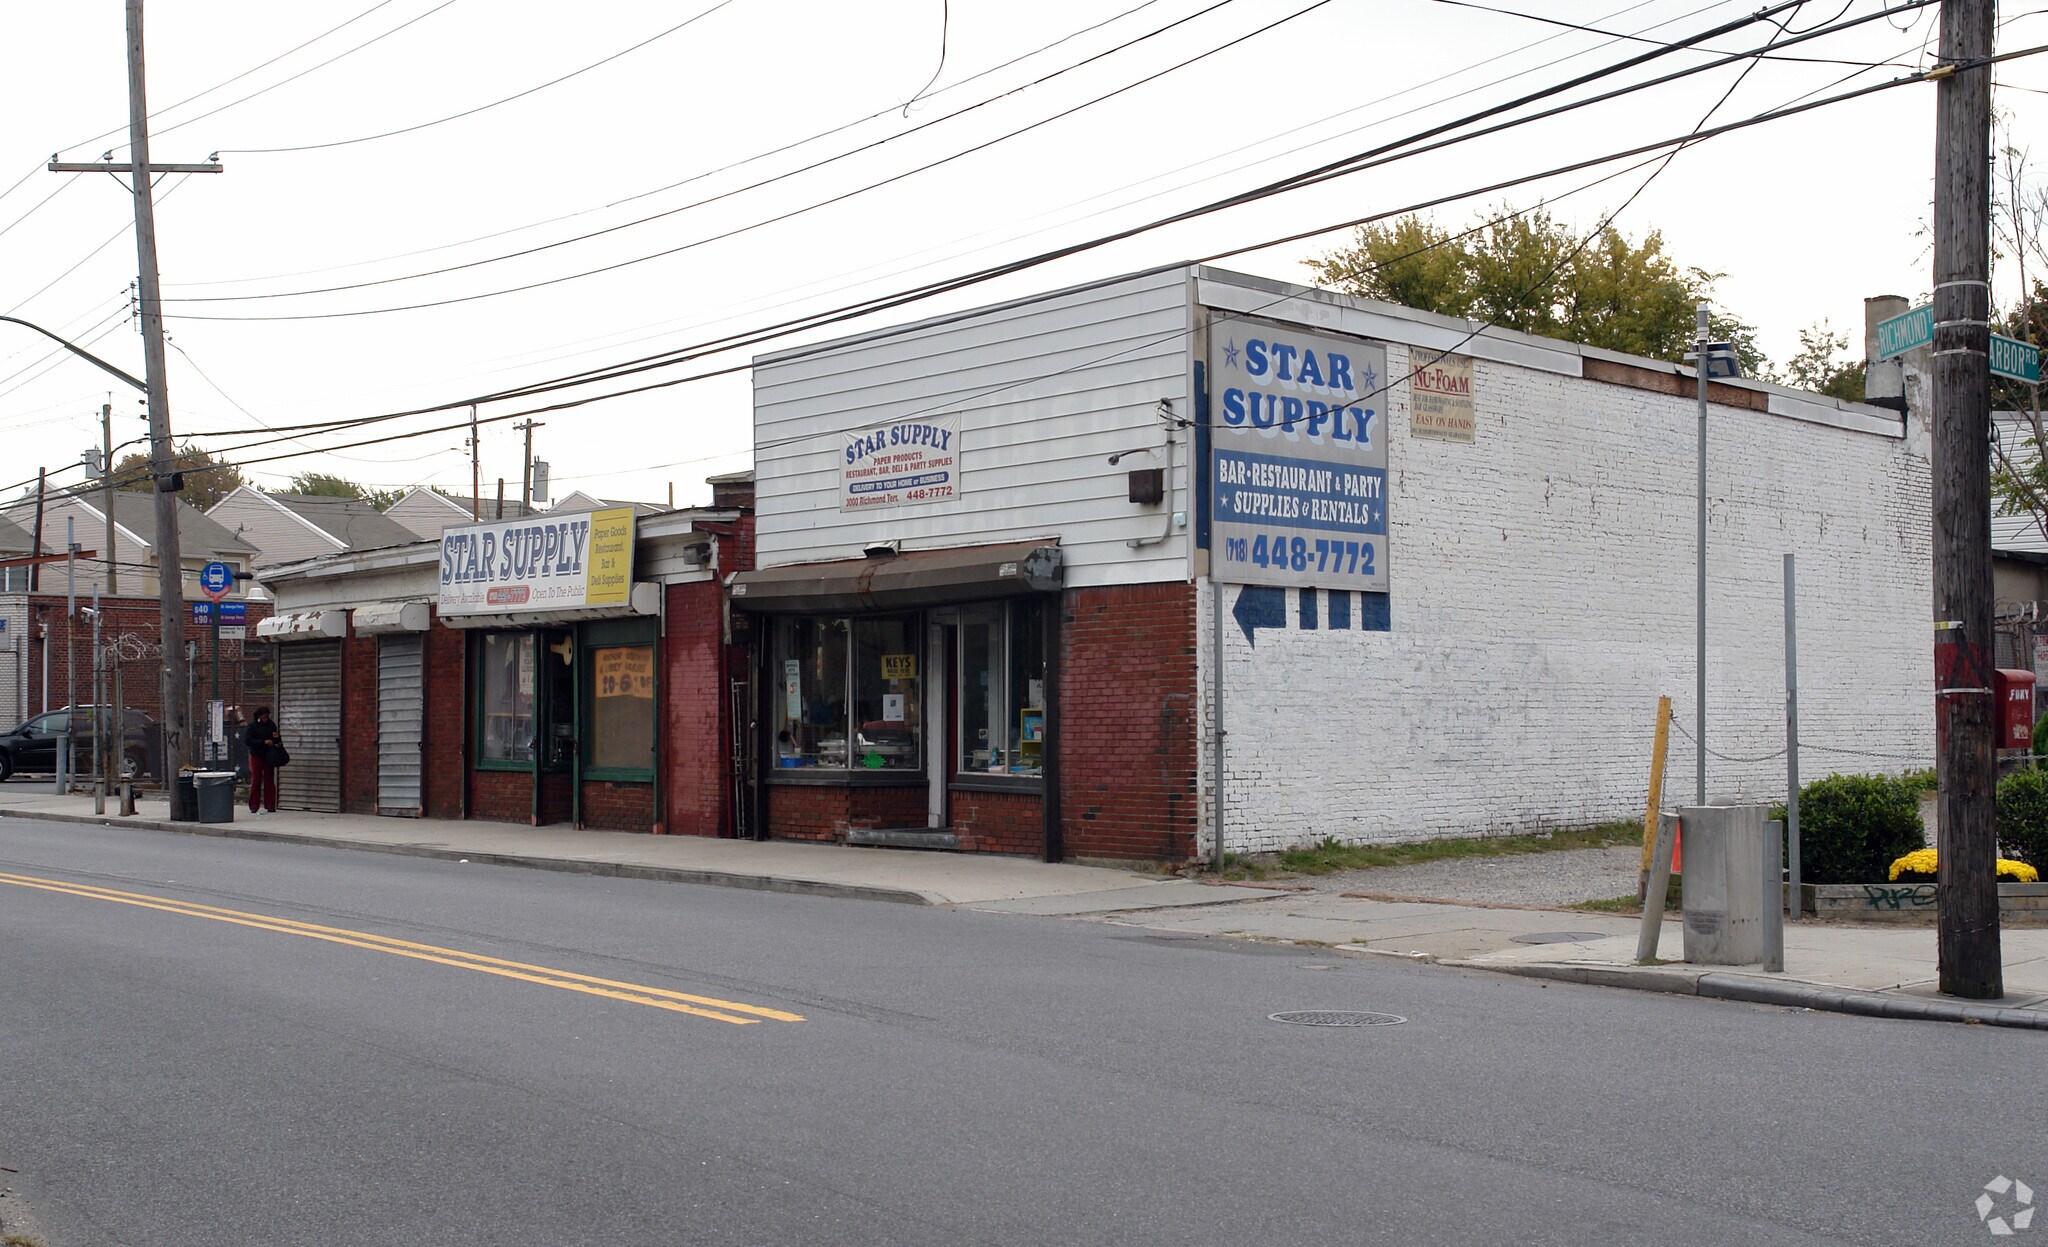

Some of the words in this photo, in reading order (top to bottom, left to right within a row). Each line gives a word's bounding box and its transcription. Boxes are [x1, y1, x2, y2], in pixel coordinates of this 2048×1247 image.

[1879, 313, 1928, 355] RICHMOND
[1245, 338, 1356, 395] STAR
[2025, 350, 2037, 366] RD
[1222, 386, 1376, 448] SUPPLY
[1416, 414, 1434, 425] EASY
[1436, 416, 1445, 428] ON
[1448, 417, 1472, 430] HANDS
[846, 429, 887, 465] STAR
[890, 424, 953, 452] SUPPLY
[873, 455, 892, 466] PAPER
[893, 451, 923, 463] PRODUCTS
[892, 465, 903, 474] DELI
[904, 463, 909, 471] &
[910, 461, 927, 471] PARTY
[928, 457, 953, 468] SUPPLIES
[852, 482, 875, 492] DELIVERY
[875, 482, 883, 490] TO
[883, 480, 897, 489] YOUR
[898, 478, 913, 488] HOME
[920, 474, 945, 484] BUSINESS
[1335, 480, 1342, 491] &
[1344, 472, 1382, 499] PARTY
[846, 497, 859, 507] 3000
[859, 494, 886, 507] Richmond
[907, 486, 953, 501] 448-7772
[1233, 490, 1300, 518] SUPPLIES
[1301, 503, 1309, 517] &
[1311, 502, 1369, 525] RENTALS
[594, 527, 609, 540] Paper
[611, 525, 627, 538] Goods
[442, 531, 497, 586] STAR
[500, 520, 589, 582] SUPPLY
[1225, 535, 1248, 563] (718)
[1252, 534, 1375, 576] 448-7772
[601, 559, 609, 569] Bar
[610, 559, 615, 569] &
[591, 575, 601, 586] Deli
[602, 574, 625, 588] Supplies
[532, 588, 547, 601] Open
[548, 587, 556, 599] To
[556, 586, 567, 598] The
[567, 584, 585, 597] Public
[886, 657, 911, 668] KEYS
